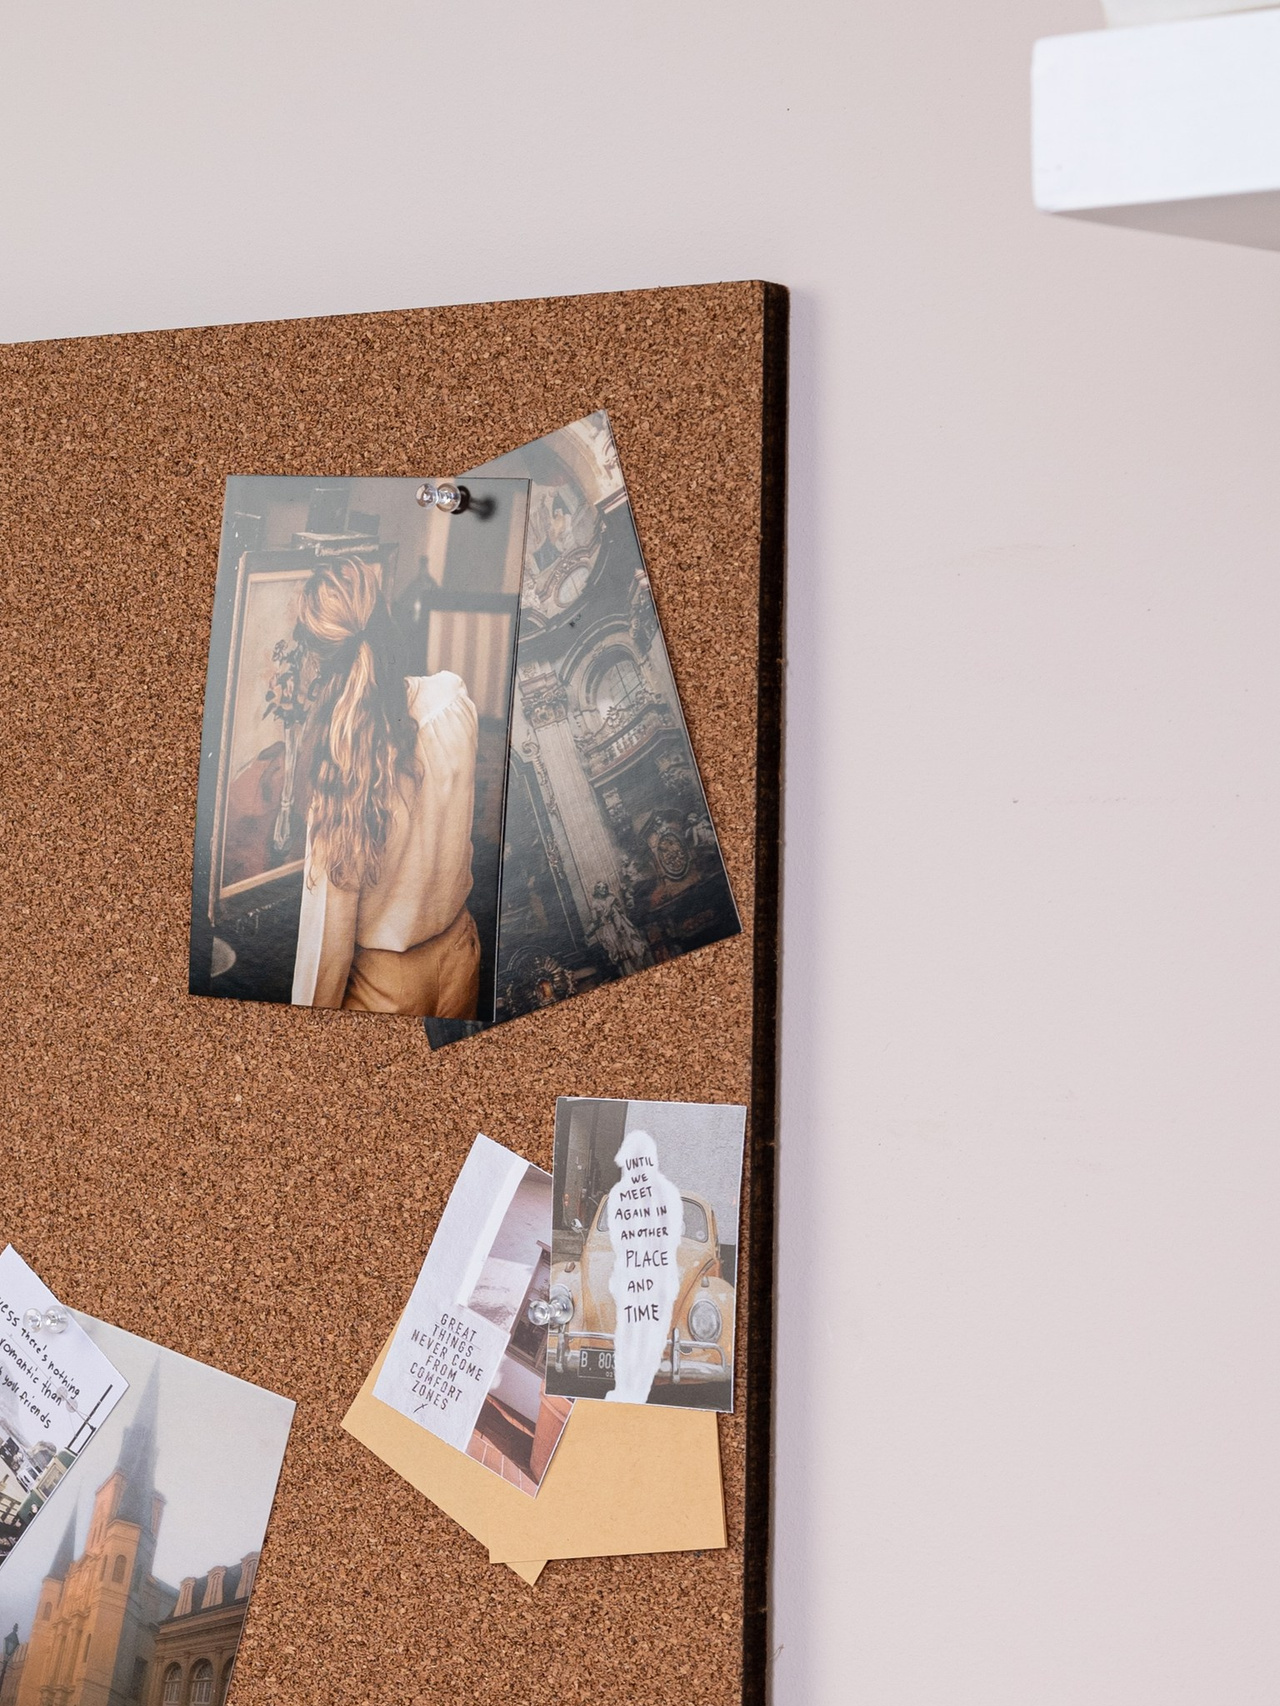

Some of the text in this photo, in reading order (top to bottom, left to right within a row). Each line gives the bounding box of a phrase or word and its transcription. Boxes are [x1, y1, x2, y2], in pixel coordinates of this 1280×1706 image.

[625, 1156, 654, 1171] UNTIL
[631, 1173, 649, 1184] WE
[620, 1186, 652, 1202] MEET
[615, 1205, 667, 1221] AGAIN IN
[621, 1226, 669, 1240] ANOTHER
[626, 1249, 669, 1268] PLACE
[627, 1279, 654, 1293] AND
[624, 1303, 660, 1323] TIME
[433, 1324, 474, 1357] THINGS
[440, 1313, 477, 1342] GREAT
[411, 1329, 484, 1381] NEVER COME
[425, 1355, 458, 1382] FROM
[0, 1338, 40, 1384] romantic
[41, 1378, 63, 1406] than
[48, 1361, 81, 1399] nothing
[410, 1362, 462, 1402] COMFORT
[2, 1375, 20, 1393] your
[19, 1391, 52, 1429] friends
[411, 1380, 448, 1410] ZONES
